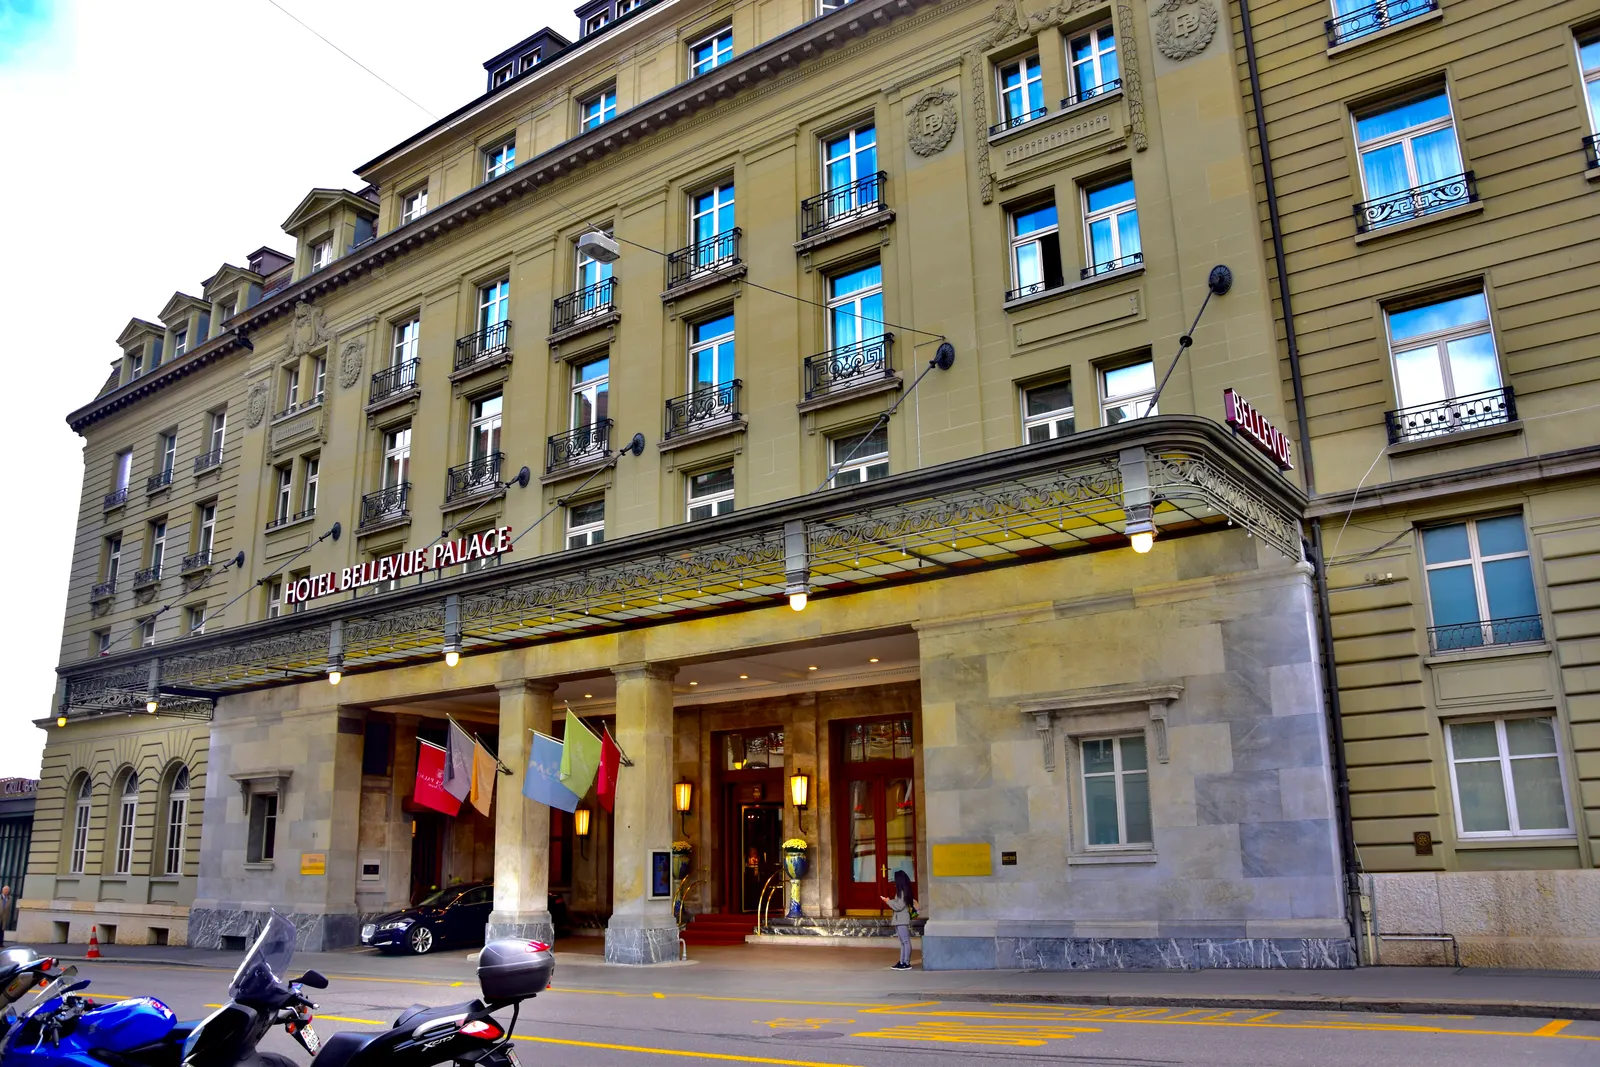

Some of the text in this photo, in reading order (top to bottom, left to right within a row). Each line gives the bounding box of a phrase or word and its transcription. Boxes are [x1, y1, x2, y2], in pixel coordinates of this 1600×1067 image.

[1232, 389, 1294, 470] BELLEVUE
[284, 525, 512, 604] HOTEL BELLEVUE PALACE
[1067, 1007, 1284, 1023] HOTEL
